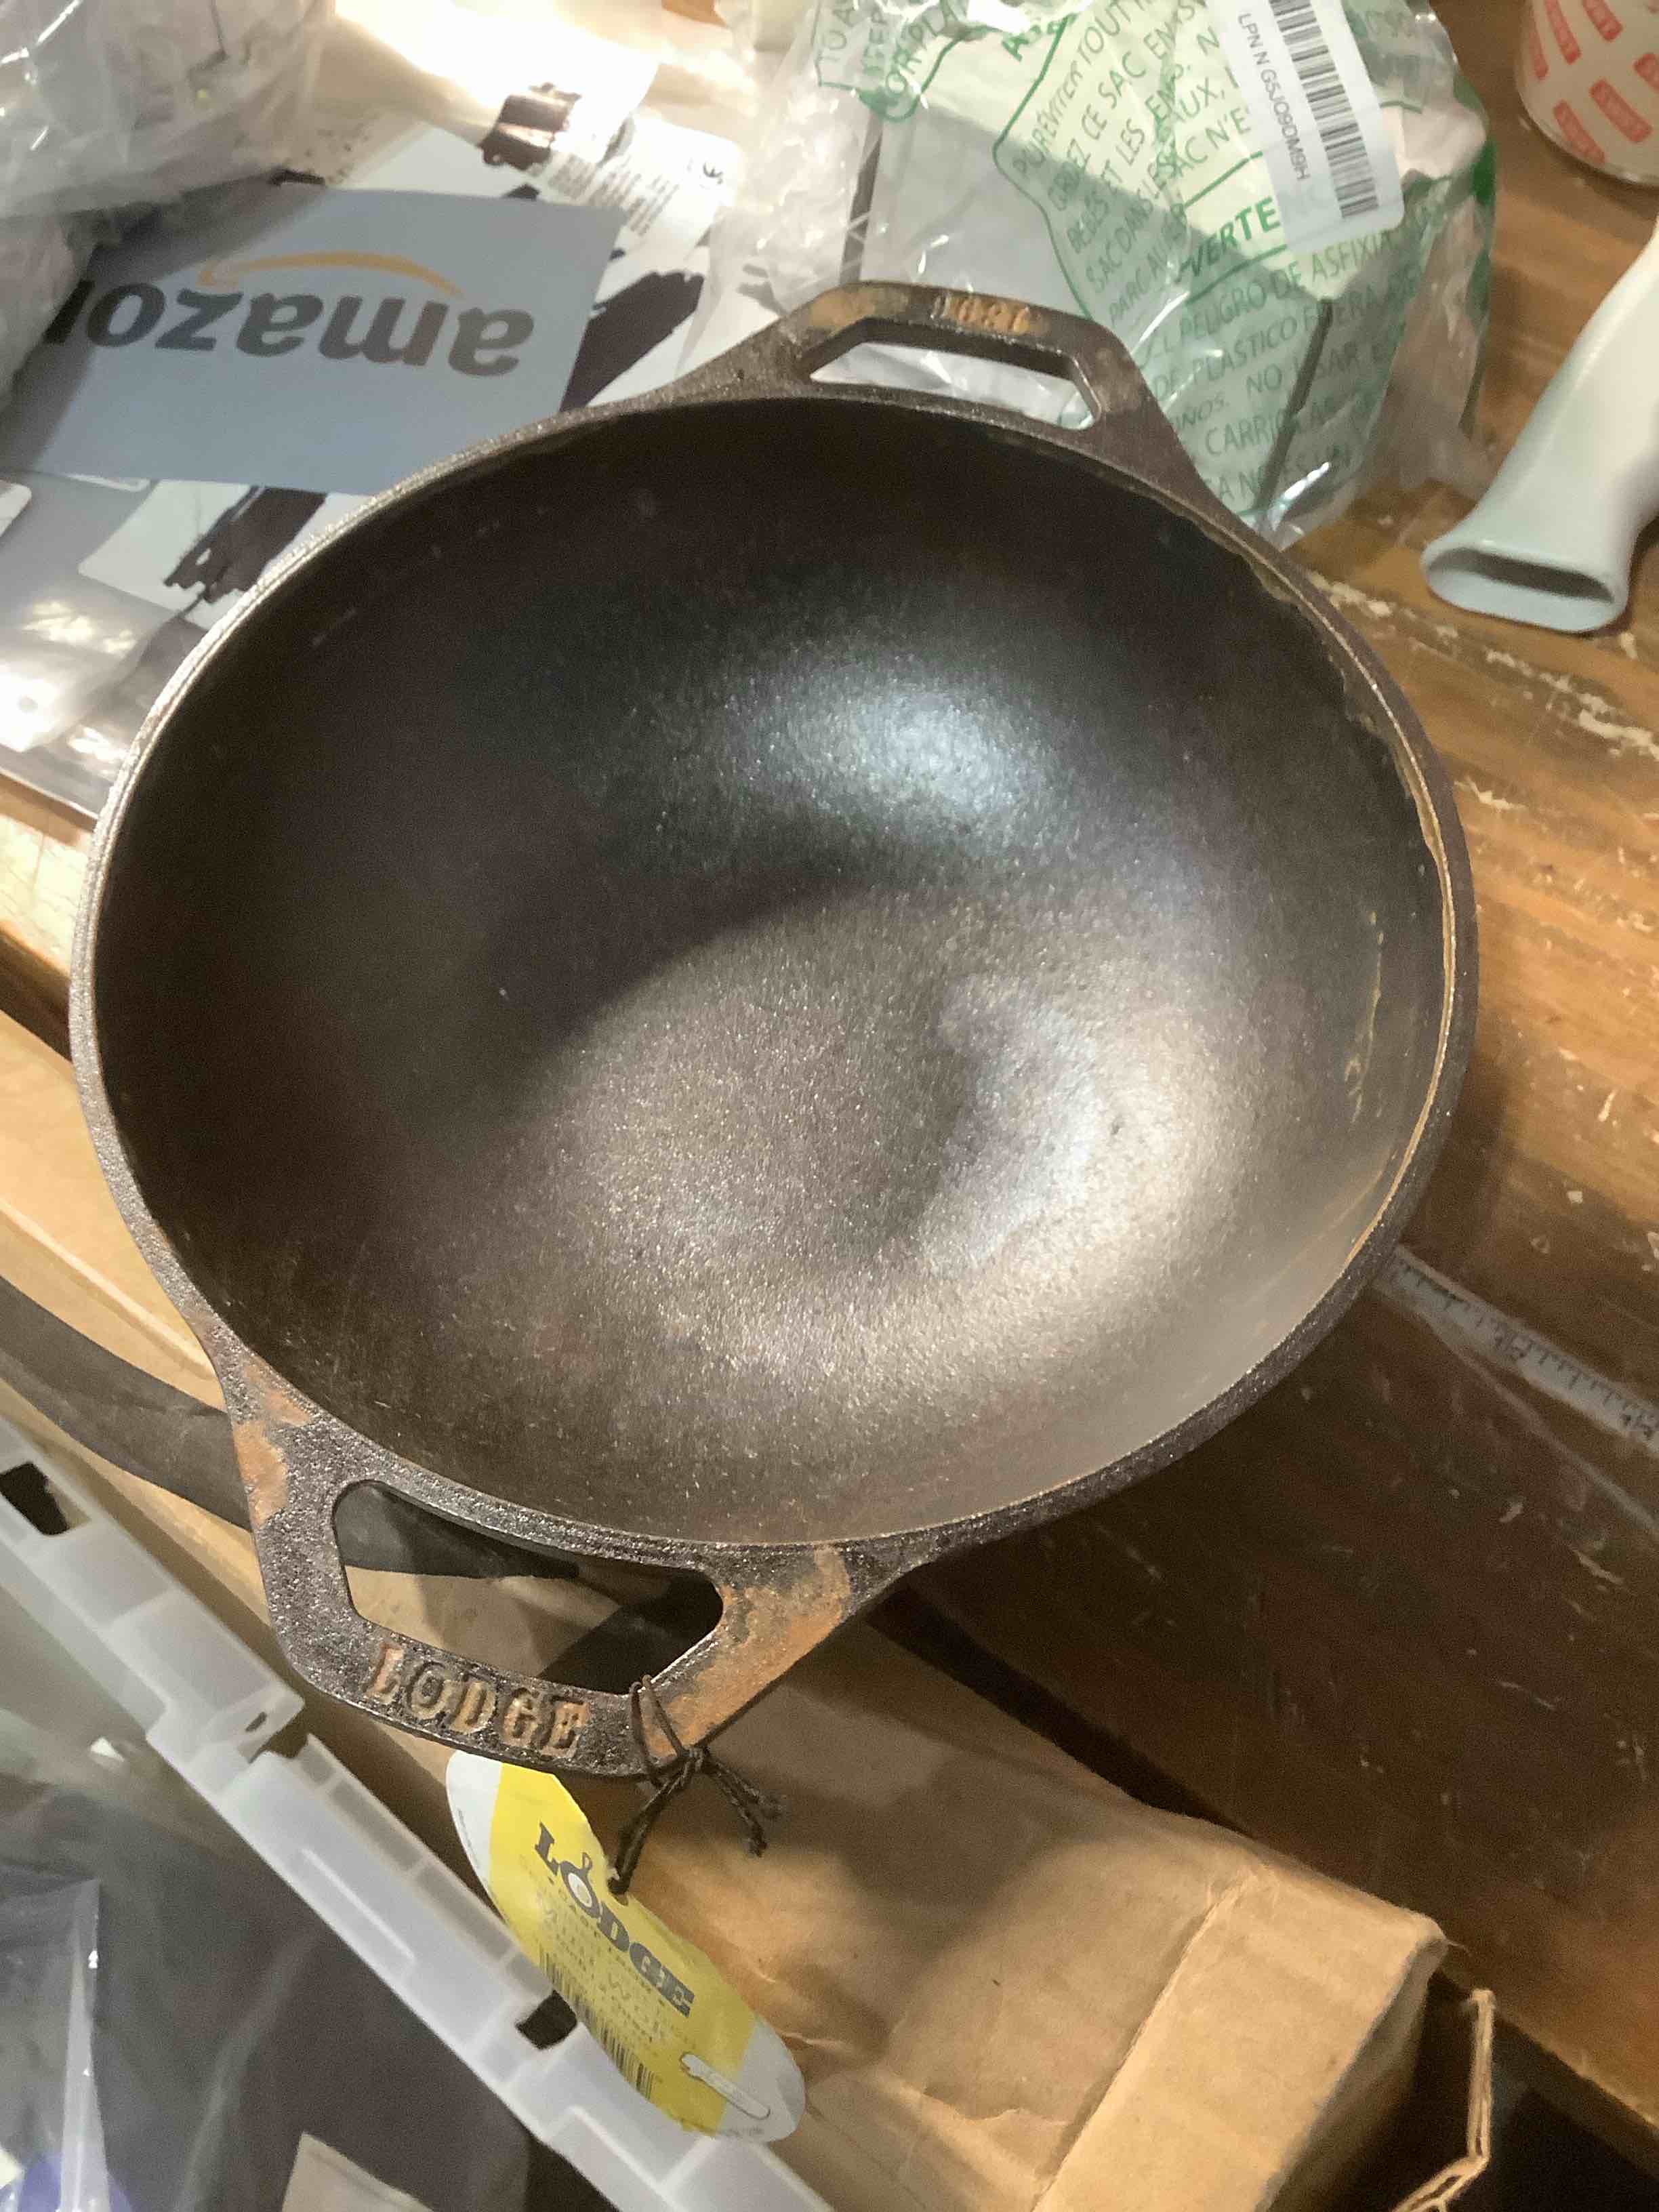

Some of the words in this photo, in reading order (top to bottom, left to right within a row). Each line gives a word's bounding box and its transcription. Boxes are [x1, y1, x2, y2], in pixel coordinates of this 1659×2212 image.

[1082, 104, 1107, 140] CE
[1098, 50, 1147, 110] SAC
[1115, 119, 1145, 166] LES
[1246, 363, 1283, 400] NO
[365, 1641, 592, 1761] LODGE
[533, 1822, 695, 2018] LODGE
